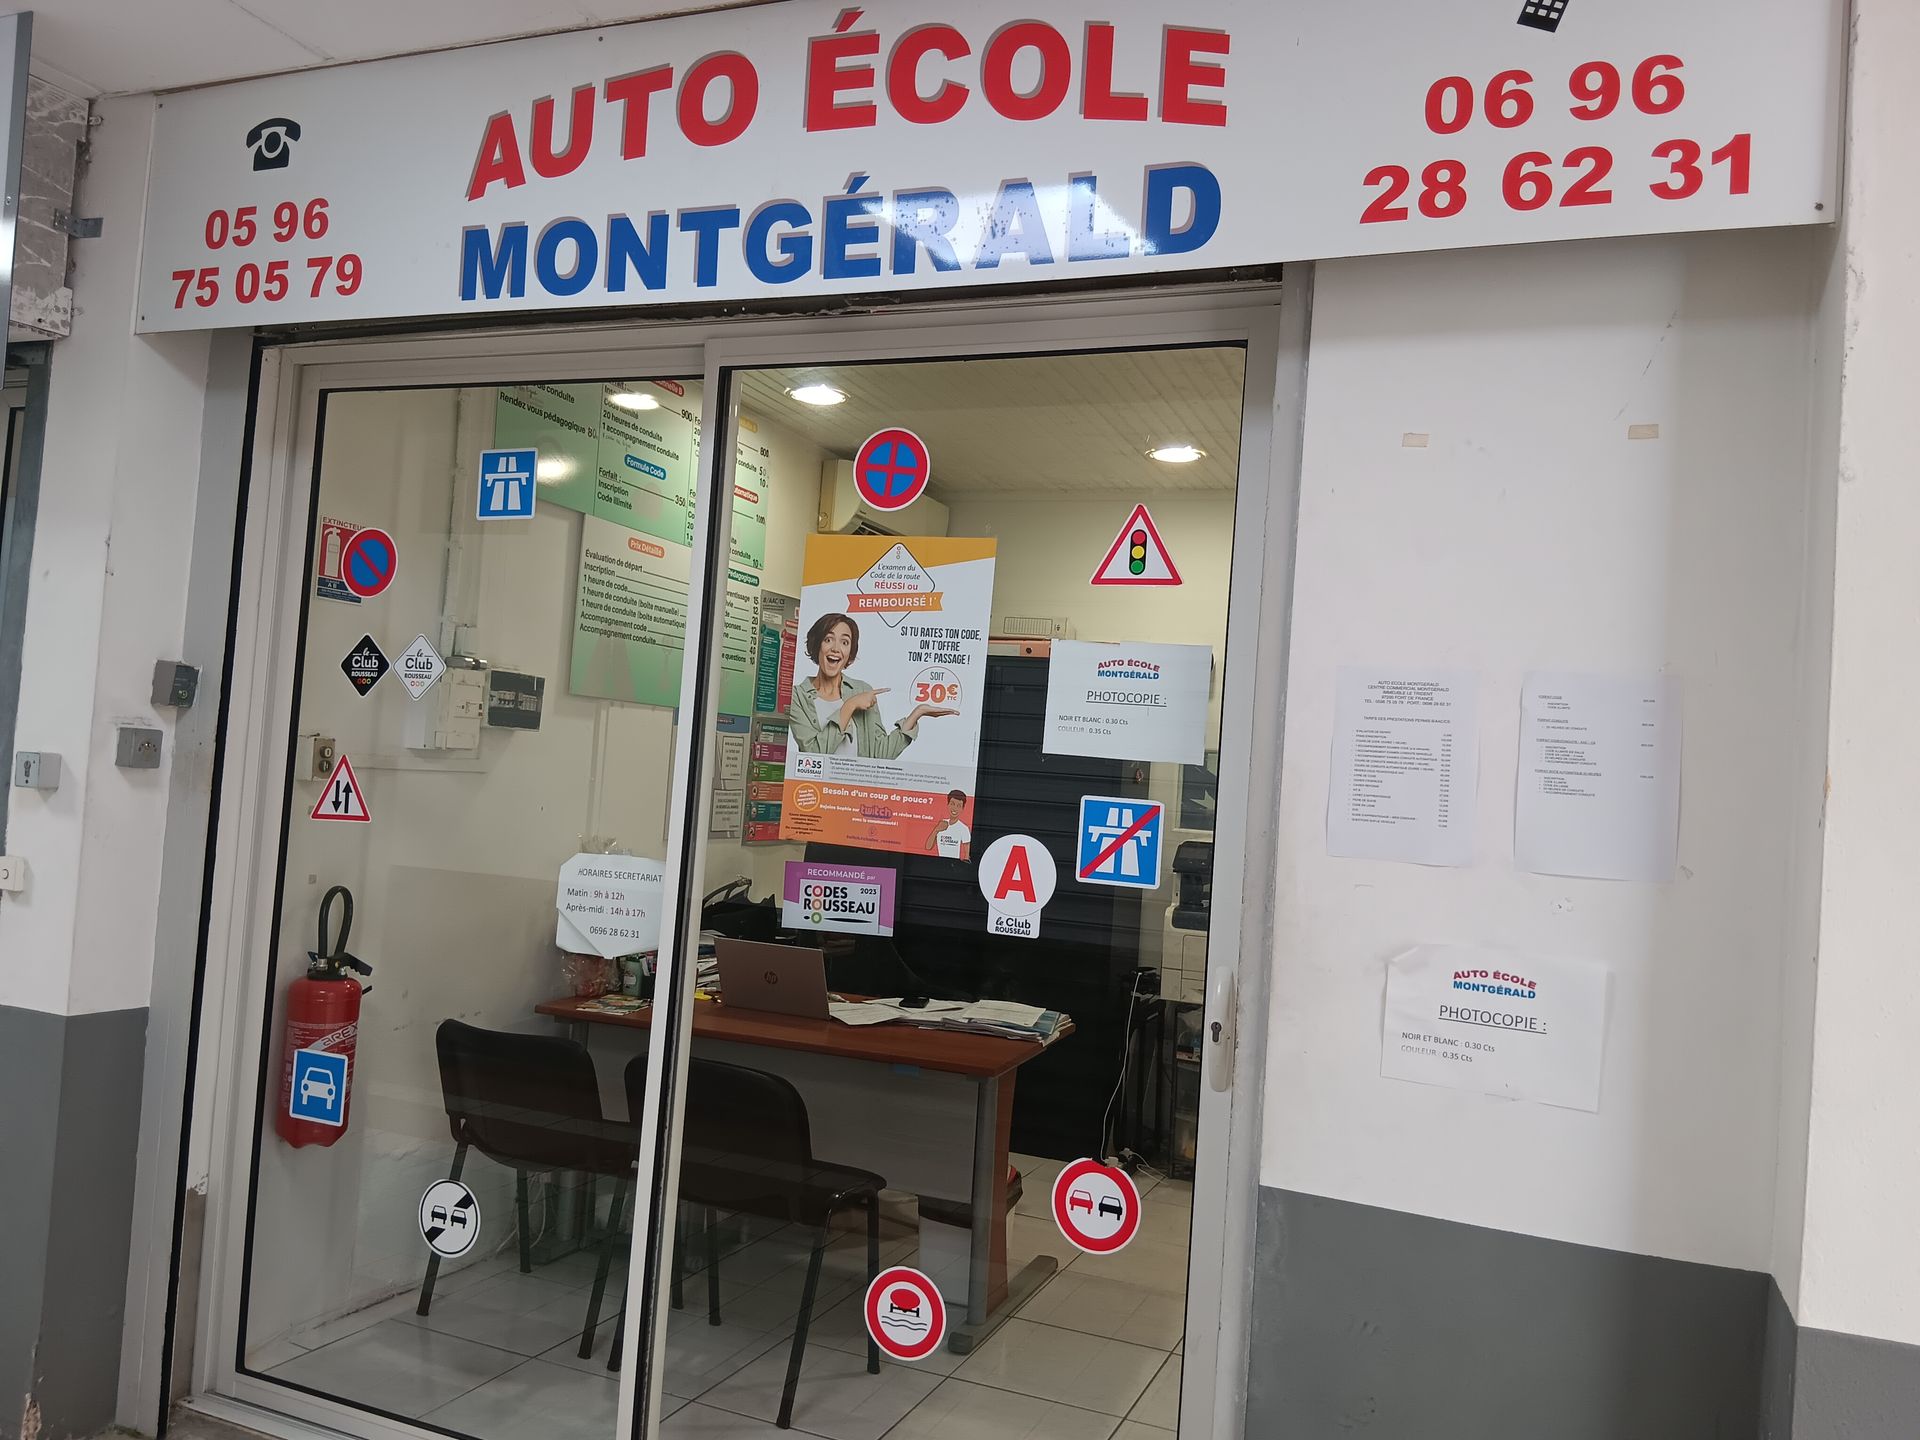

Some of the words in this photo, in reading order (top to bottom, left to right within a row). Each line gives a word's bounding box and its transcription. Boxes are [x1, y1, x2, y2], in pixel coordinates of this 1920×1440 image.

[1424, 68, 1534, 135] 06
[1568, 54, 1685, 121] 96
[465, 50, 759, 201] AUTO
[803, 6, 1230, 132] ÉCOLE
[1359, 159, 1467, 224] 28
[1502, 146, 1613, 211] 62
[1649, 133, 1751, 200] 31
[204, 206, 257, 250] 05
[273, 198, 329, 243] 96
[458, 161, 1222, 301] MONTGÉRALD
[172, 267, 219, 309] 75
[235, 260, 289, 304] 05
[305, 253, 363, 298] 79
[500, 391, 526, 409] Rendez
[527, 404, 543, 416] vous
[544, 410, 586, 433] pédagogique
[603, 410, 610, 420] 20
[612, 413, 630, 429] heures
[631, 421, 638, 431] de
[639, 426, 662, 442] conduite
[606, 424, 656, 450] accompagnement
[657, 446, 679, 460] conduite
[627, 457, 649, 472] Formule
[650, 466, 664, 478] Code
[599, 480, 628, 496] Inscription
[597, 492, 612, 503] Code
[586, 549, 615, 564] Évaluation
[616, 557, 623, 567] de
[584, 562, 615, 577] Inscription
[870, 571, 885, 579] Code
[588, 575, 604, 586] heure
[605, 580, 612, 588] de
[613, 582, 628, 592] code
[874, 580, 905, 590] RÉUSSI
[587, 587, 603, 598] heure
[605, 592, 612, 600] de
[613, 594, 637, 606] conduite
[858, 595, 926, 607] REMBOURSÉ
[586, 599, 602, 610] heure
[603, 603, 611, 612] de
[612, 606, 636, 617] conduite
[581, 611, 632, 628] Accompagnement
[633, 622, 647, 632] code
[580, 623, 632, 641] Accompagnement
[633, 634, 656, 645] conduite
[901, 626, 907, 636] SI
[909, 626, 918, 637] TU
[920, 627, 943, 638] RATES
[945, 628, 959, 639] TON
[961, 629, 981, 641] CODE,
[363, 647, 369, 656] le
[920, 640, 930, 650] ON
[932, 640, 960, 651] T'OFFRE
[417, 649, 424, 658] le
[908, 651, 922, 662] TON
[933, 652, 966, 664] PASSAGE
[352, 656, 378, 668] Club
[405, 657, 433, 670] Club
[1098, 659, 1124, 669] AUTO
[1127, 658, 1160, 672] ÉCOLE
[930, 671, 944, 681] SOIT
[1097, 670, 1159, 680] MONTGÉRALD
[1087, 690, 1160, 704] PHOTOCOPIE
[798, 758, 822, 769] PASS
[823, 787, 849, 796] Besoin
[850, 789, 868, 798] d'un
[869, 792, 888, 801] coup
[890, 793, 901, 801] de
[860, 804, 892, 817] twitch
[577, 868, 613, 879] HORAIRES
[614, 871, 663, 883] SECRETARIAT
[807, 868, 866, 880] RECOMMANDÉ
[994, 845, 1037, 903] A
[567, 888, 588, 897] Matin
[594, 890, 603, 899] 9h
[605, 890, 609, 899] à
[611, 892, 625, 900] 12h
[804, 884, 848, 900] CODES
[860, 888, 877, 896] 2023
[566, 903, 604, 914] Après-midi
[610, 907, 623, 916] 14h
[625, 908, 630, 916] à
[632, 909, 645, 918] 17h
[803, 898, 875, 915] ROUSSEAU
[996, 917, 1004, 926] le
[1006, 917, 1031, 929] Club
[589, 926, 607, 936] 0696
[609, 928, 618, 937] 28
[620, 928, 628, 938] 62
[631, 930, 640, 939] 31
[995, 926, 1031, 936] ROUSSEAU
[1453, 970, 1489, 980] AUTO
[1493, 970, 1537, 990] ÉCOLE
[1453, 980, 1536, 999] MONTGÉRALD
[1439, 1005, 1538, 1031] PHOTOCOPIE
[1402, 1032, 1420, 1041] NOIR
[1423, 1034, 1432, 1042] ET
[1434, 1037, 1459, 1046] BLANC
[1464, 1041, 1482, 1050] 0.30
[1483, 1044, 1495, 1053] Cts
[1401, 1045, 1437, 1056] COULEUR
[1442, 1051, 1459, 1060] 0.35
[1461, 1054, 1473, 1062] Cts
